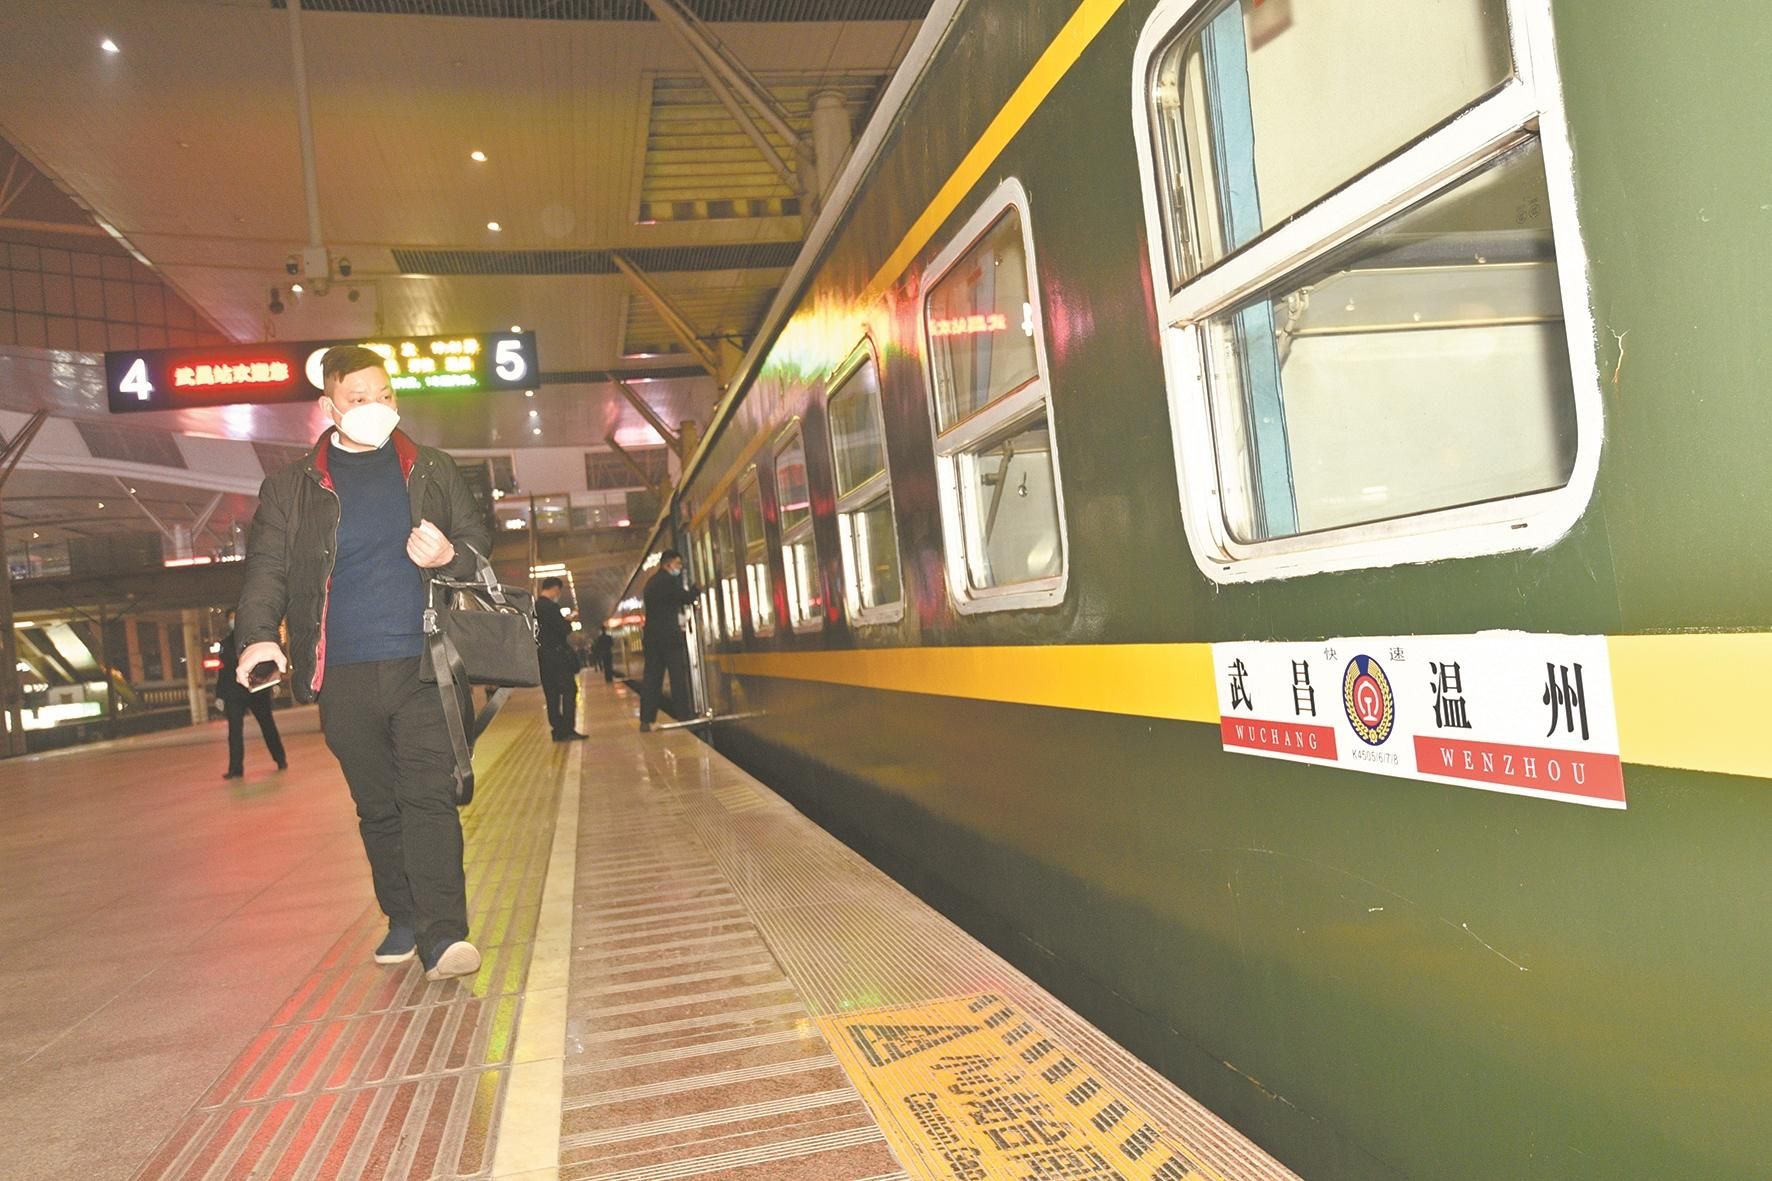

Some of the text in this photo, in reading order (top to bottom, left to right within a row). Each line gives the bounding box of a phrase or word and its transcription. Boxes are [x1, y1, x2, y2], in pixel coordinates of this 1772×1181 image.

[119, 358, 155, 400] 4
[496, 340, 527, 381] 5
[1235, 725, 1318, 750] WUCHANG
[1440, 747, 1586, 784] WENZHOU
